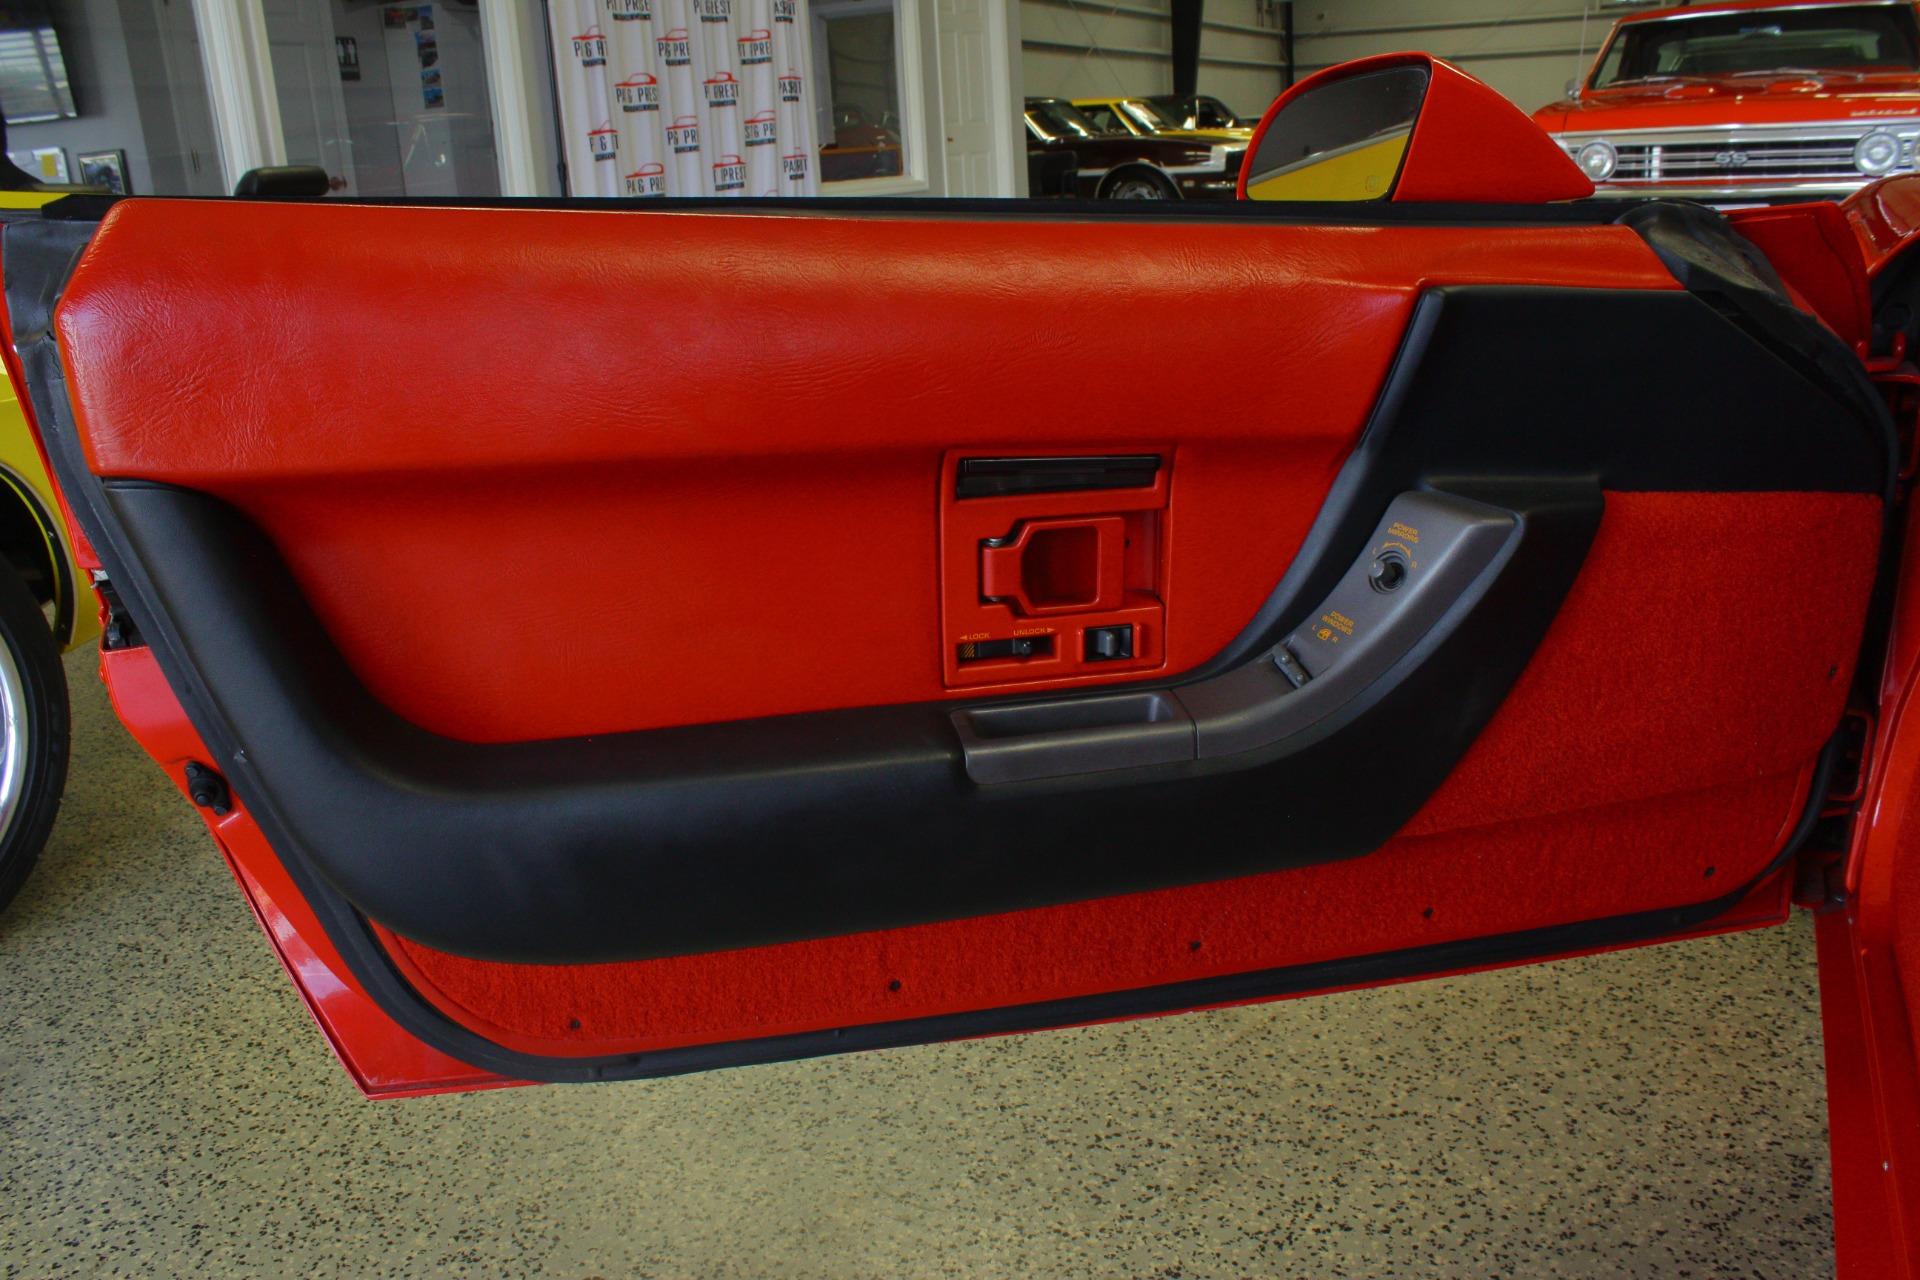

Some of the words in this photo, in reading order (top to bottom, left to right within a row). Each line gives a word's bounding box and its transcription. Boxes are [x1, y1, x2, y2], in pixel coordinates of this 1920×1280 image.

[1714, 151, 1749, 167] SS
[968, 632, 990, 640] LOCK
[1013, 627, 1046, 637] UNLOCK
